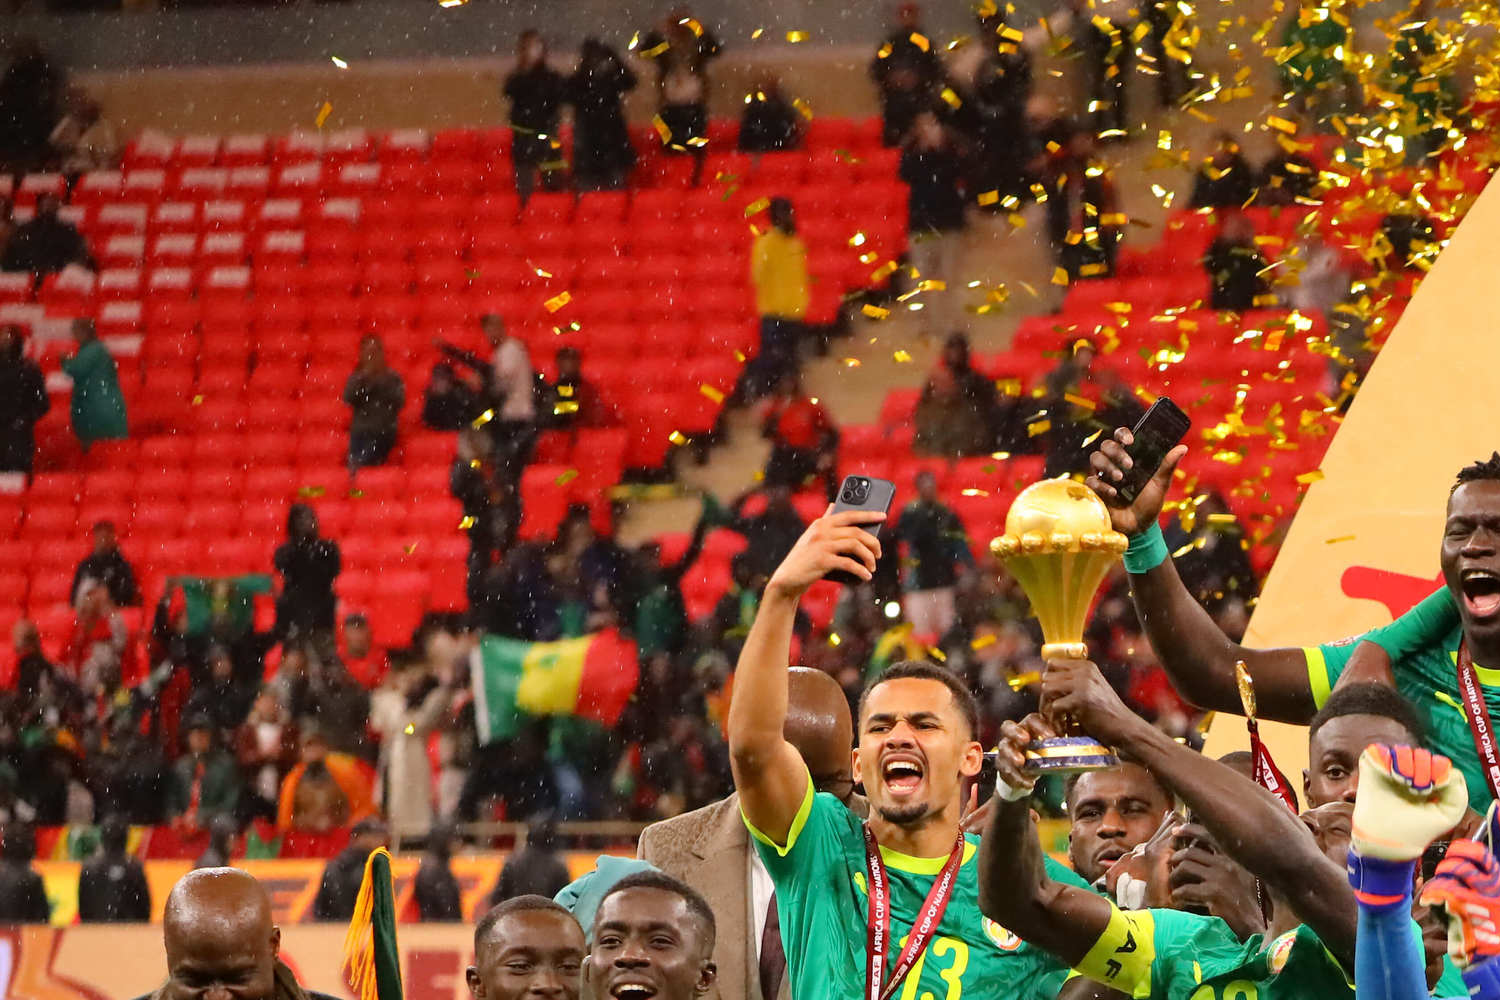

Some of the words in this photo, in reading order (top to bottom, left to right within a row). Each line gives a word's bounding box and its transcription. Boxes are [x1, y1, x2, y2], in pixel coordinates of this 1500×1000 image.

[1461, 668, 1478, 705] NATIONS
[1471, 702, 1481, 716] OF
[1476, 715, 1488, 733] CUP
[1481, 732, 1497, 764] AFRICA
[870, 855, 883, 889] NATIONS
[876, 886, 886, 900] OF
[933, 872, 952, 906] NATIONS
[876, 900, 885, 919] CUP
[927, 901, 940, 917] OF
[874, 920, 884, 953] AFRICA
[919, 915, 933, 934] CUP
[905, 933, 925, 964] AFRICA
[872, 962, 881, 988] CAF
